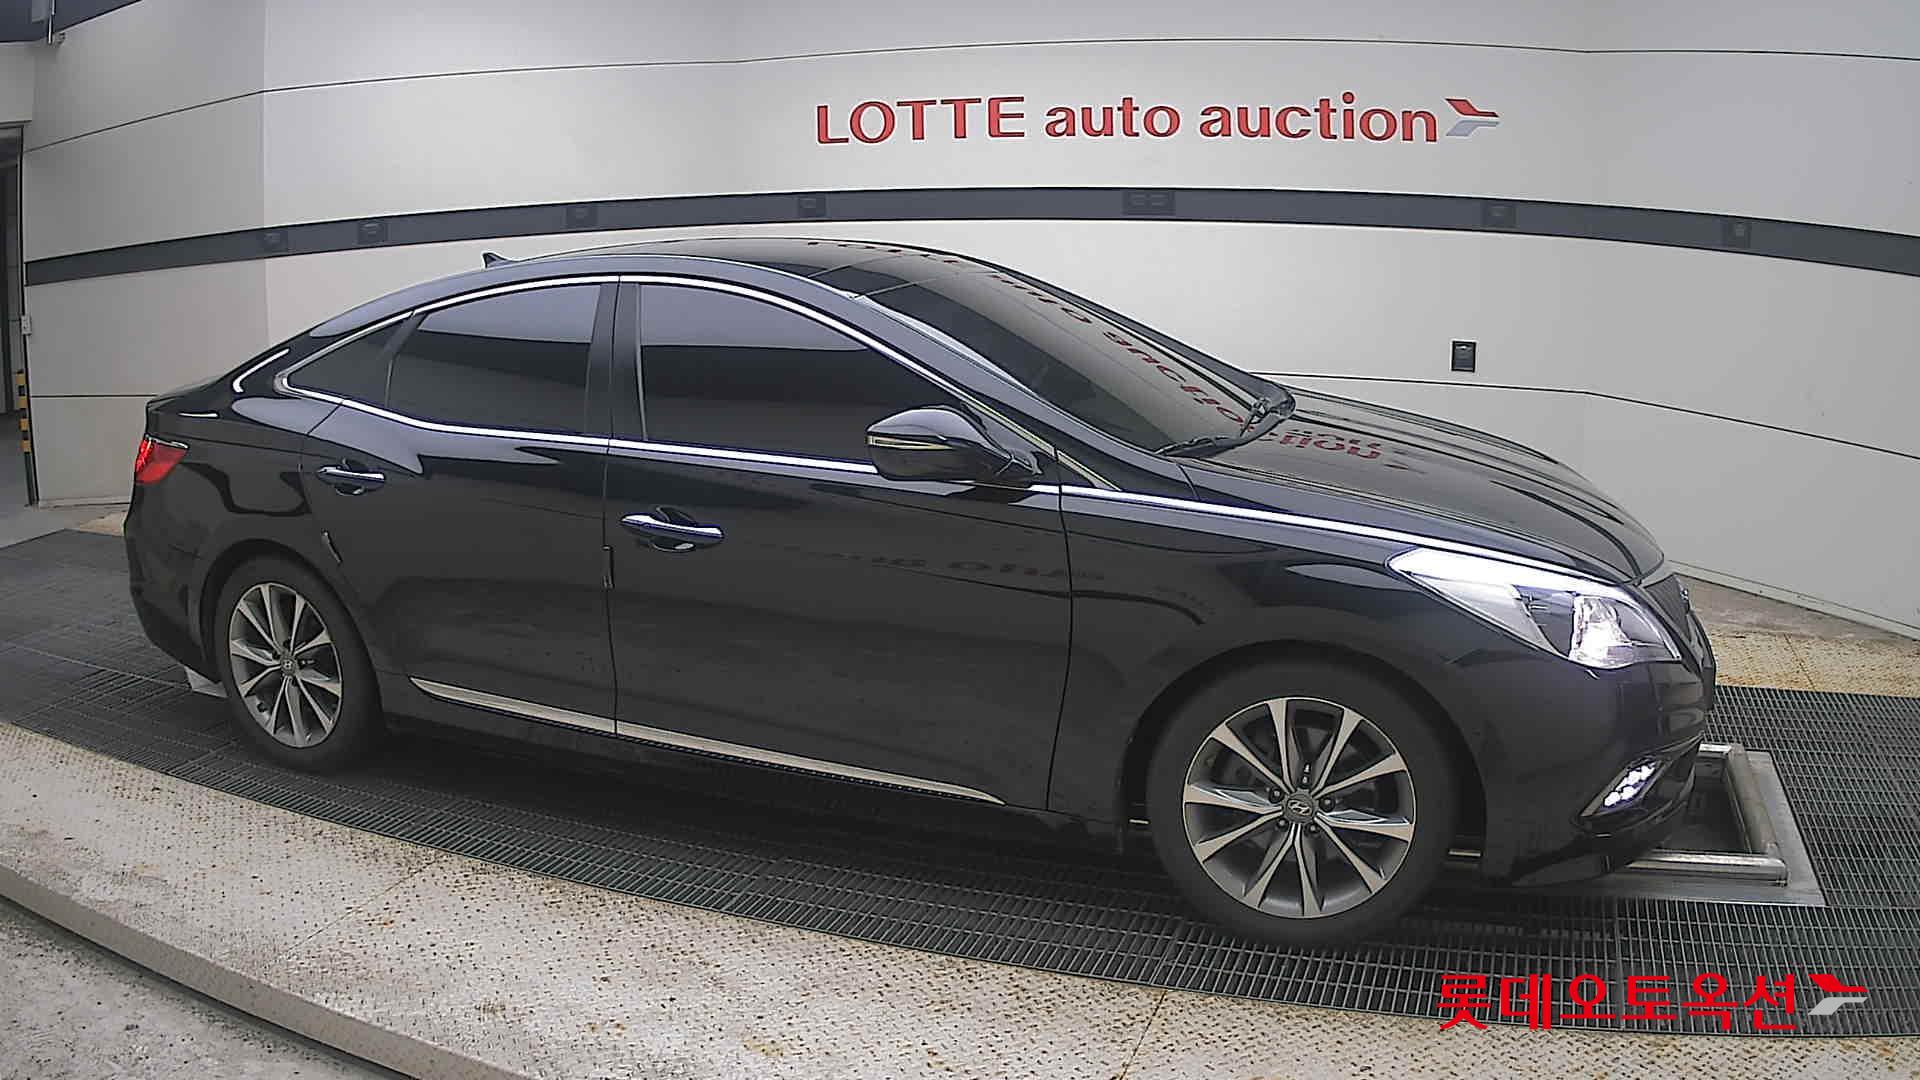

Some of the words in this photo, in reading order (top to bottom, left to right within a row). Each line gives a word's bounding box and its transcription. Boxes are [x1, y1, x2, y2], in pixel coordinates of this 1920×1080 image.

[816, 96, 1025, 144] LOTTE
[1044, 96, 1182, 139] auto
[1199, 91, 1438, 143] auction
